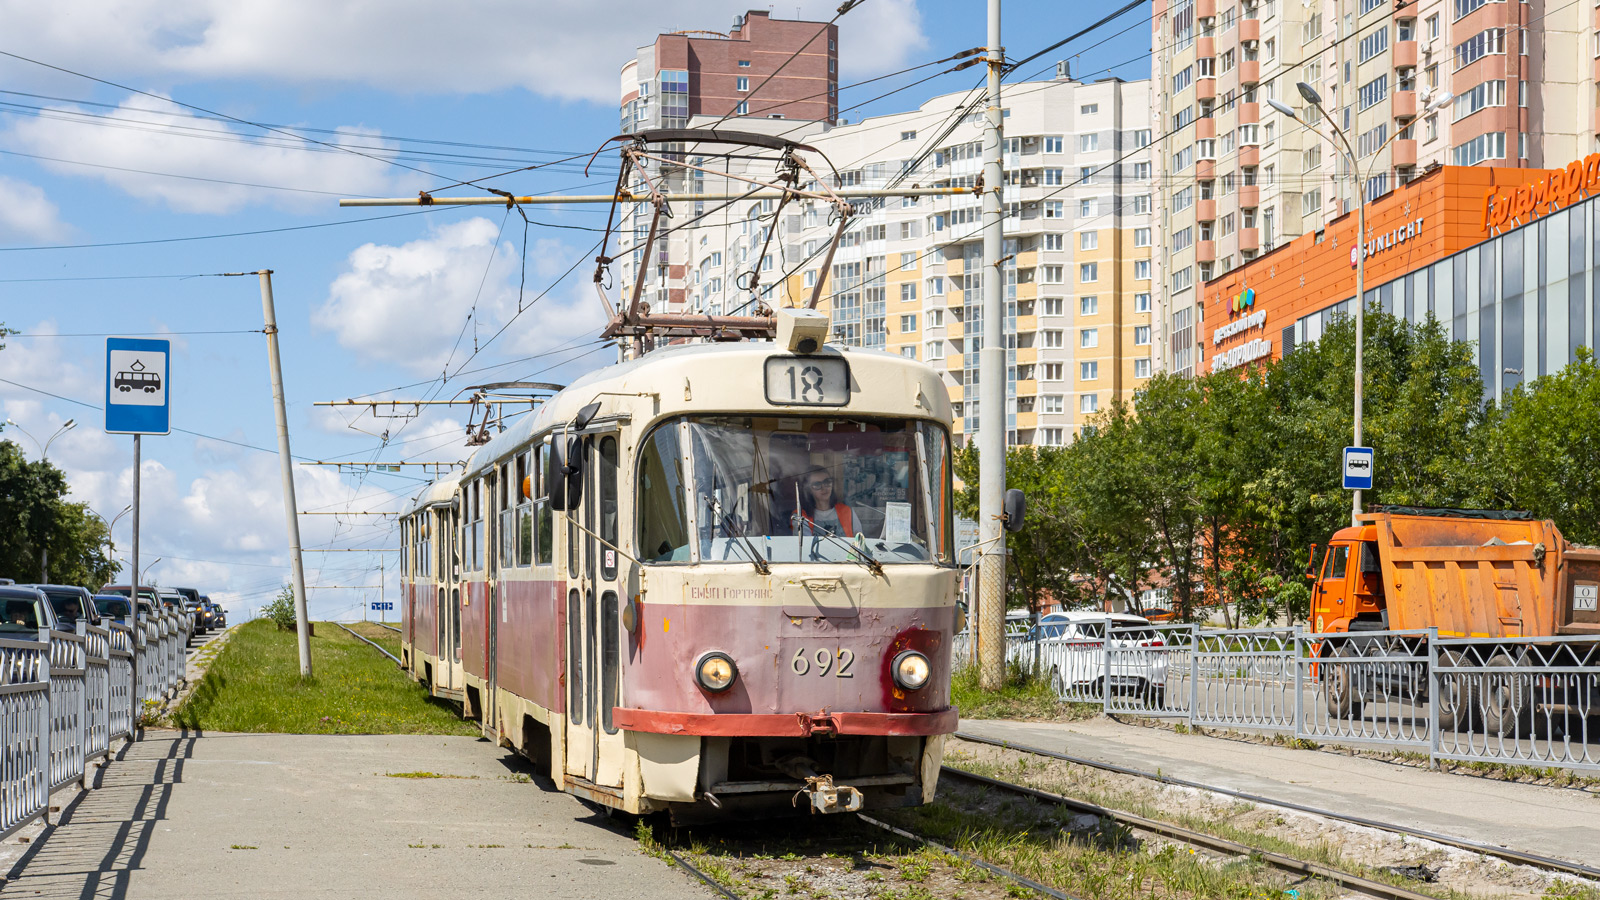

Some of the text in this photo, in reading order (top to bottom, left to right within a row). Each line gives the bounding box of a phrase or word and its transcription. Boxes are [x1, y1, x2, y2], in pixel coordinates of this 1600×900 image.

[785, 366, 825, 403] 18
[691, 587, 720, 599] ЕМУП
[791, 647, 854, 678] 692
